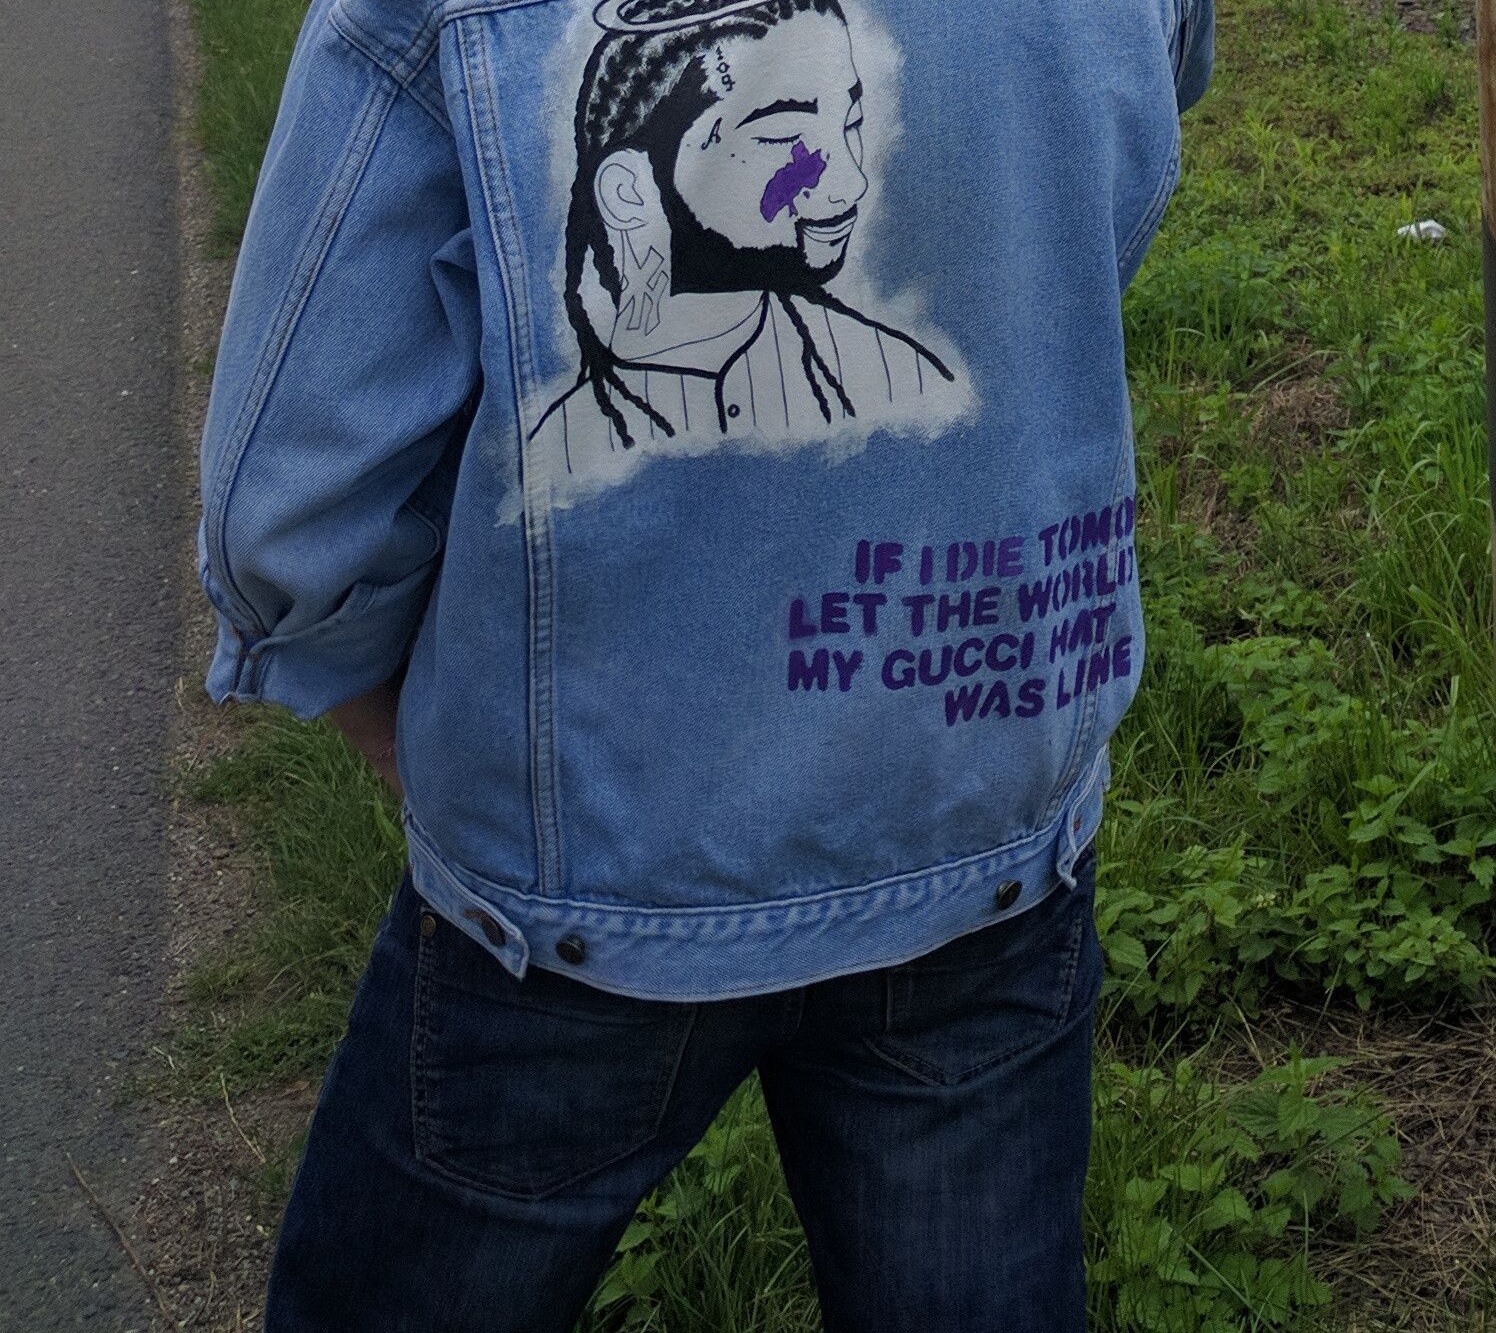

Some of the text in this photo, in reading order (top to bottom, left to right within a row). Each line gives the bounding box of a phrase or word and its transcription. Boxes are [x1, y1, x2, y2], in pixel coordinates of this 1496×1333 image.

[787, 545, 1134, 640] LET THE WORLD
[854, 538, 905, 585] IF
[919, 545, 935, 586] I
[946, 536, 1026, 584] DIE
[787, 601, 1117, 693] MY GUCCI HAT
[944, 678, 1046, 727] WAS
